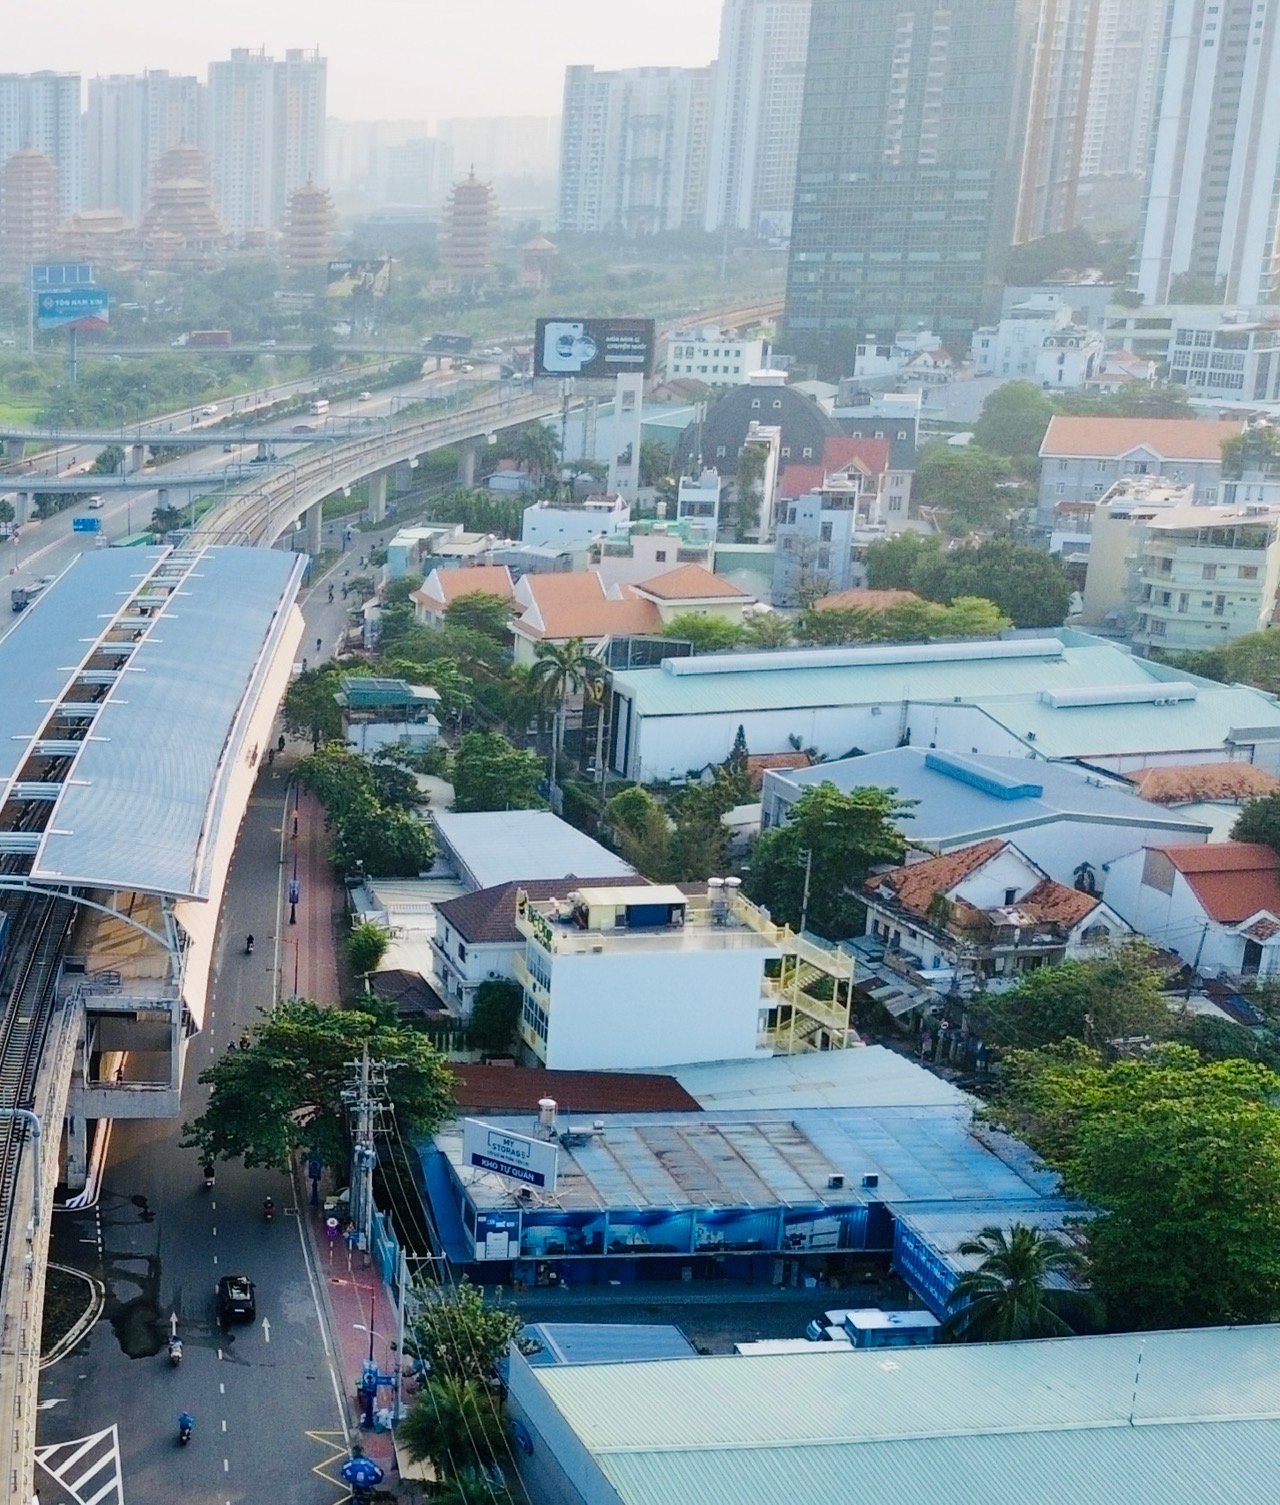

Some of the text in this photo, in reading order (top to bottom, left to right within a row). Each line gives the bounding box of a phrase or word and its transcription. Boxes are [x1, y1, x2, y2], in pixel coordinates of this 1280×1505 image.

[492, 1142, 526, 1158] STORAGE
[503, 1139, 514, 1147] MY
[481, 1158, 498, 1169] KHO
[500, 1164, 512, 1174] TỰ
